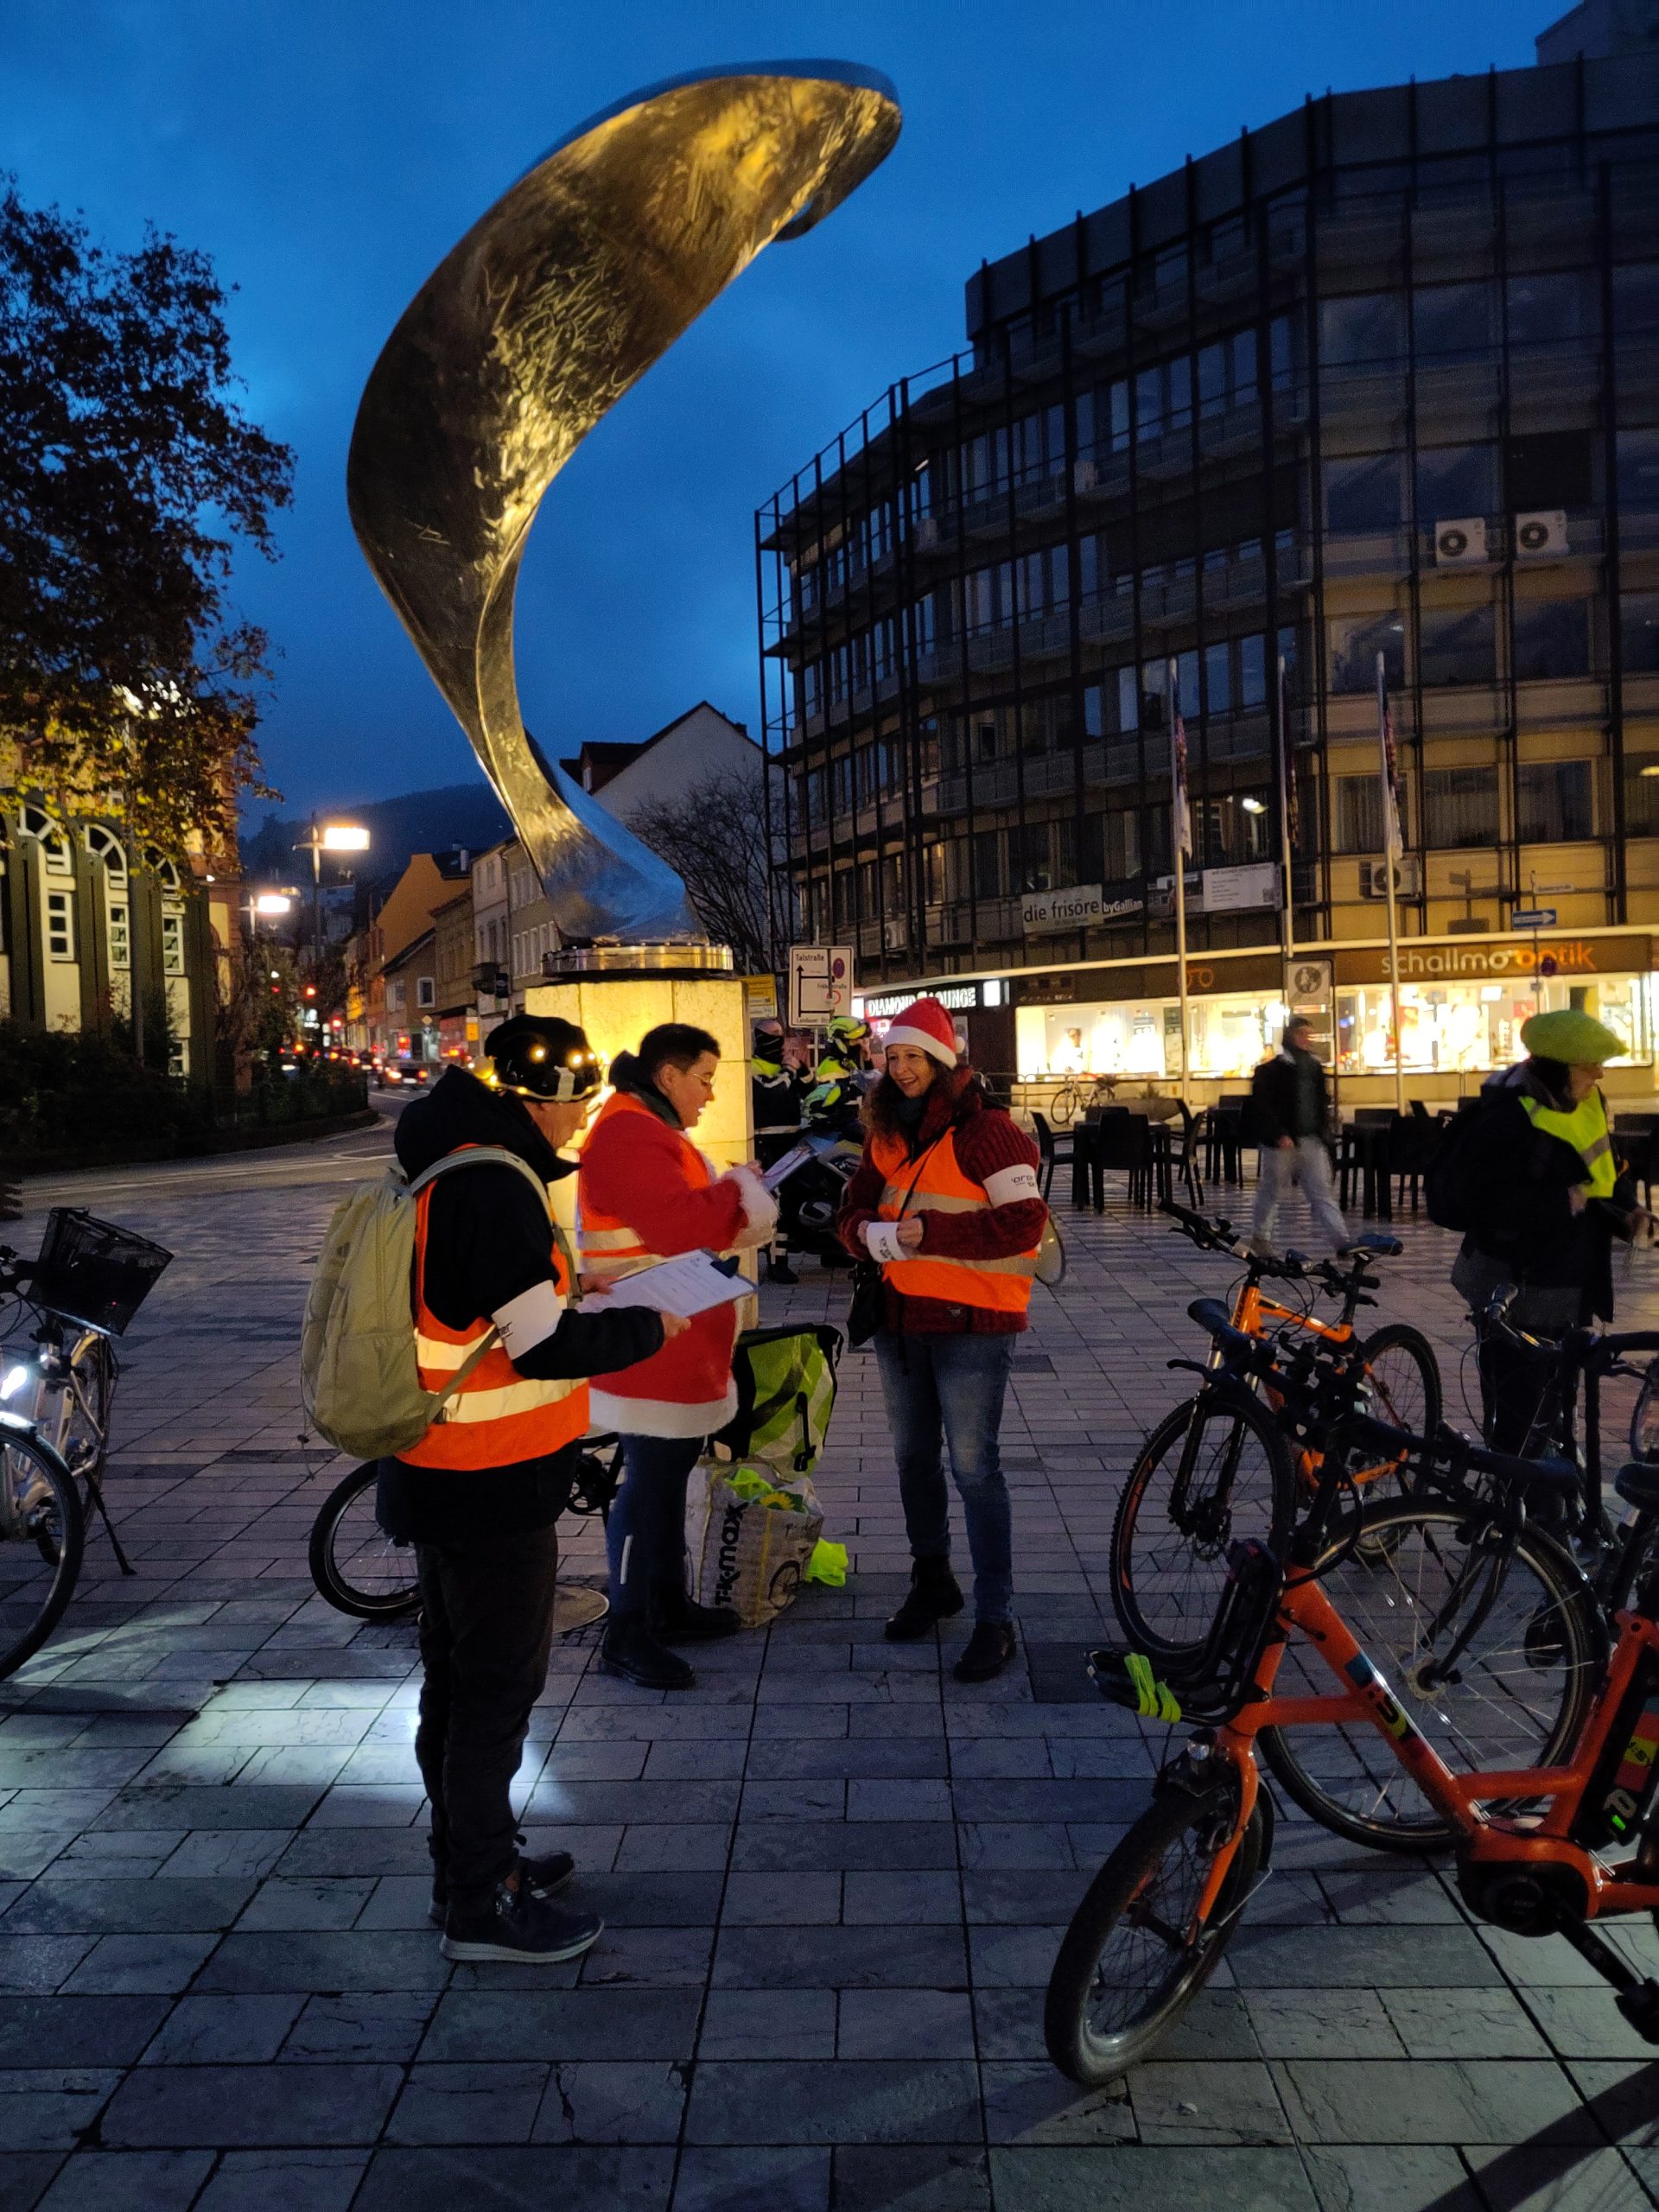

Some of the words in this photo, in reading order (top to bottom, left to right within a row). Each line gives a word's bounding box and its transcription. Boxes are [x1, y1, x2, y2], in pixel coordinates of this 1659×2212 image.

[1023, 905, 1046, 923] die
[1052, 899, 1100, 919] frisöre
[796, 953, 824, 962] Talstraße
[1381, 947, 1510, 975] schallmo
[929, 987, 976, 1009] OUNGE
